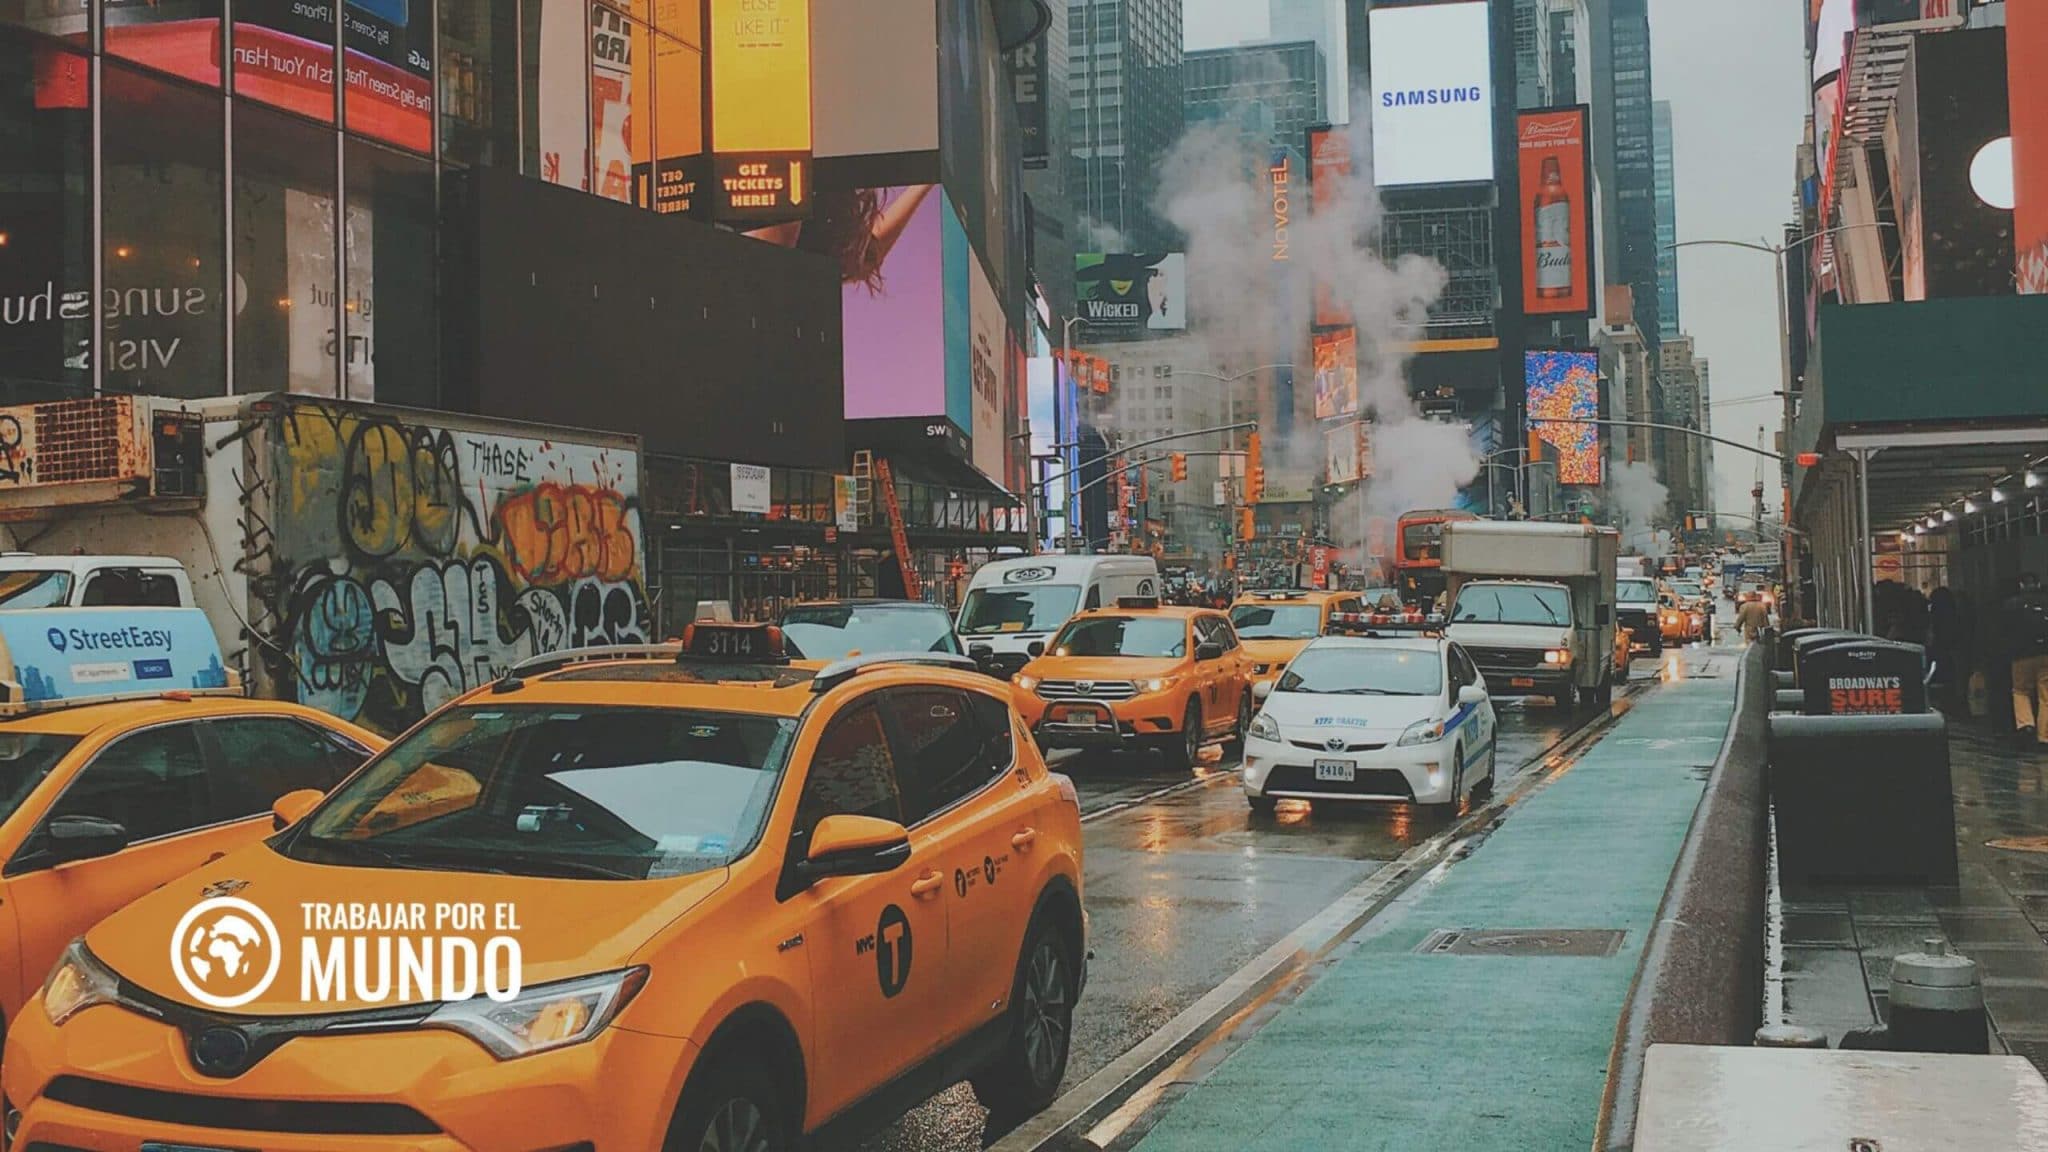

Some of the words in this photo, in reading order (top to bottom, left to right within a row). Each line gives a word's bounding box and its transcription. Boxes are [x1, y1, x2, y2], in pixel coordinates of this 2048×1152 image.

[1382, 86, 1480, 107] SAMSUNG
[739, 163, 768, 176] GET
[723, 178, 783, 190] TICKETS
[731, 193, 775, 207] HERE!
[1270, 158, 1288, 260] NOVOTEL
[69, 627, 172, 652] StreetEasy
[1829, 676, 1900, 689] BROADWAY'S
